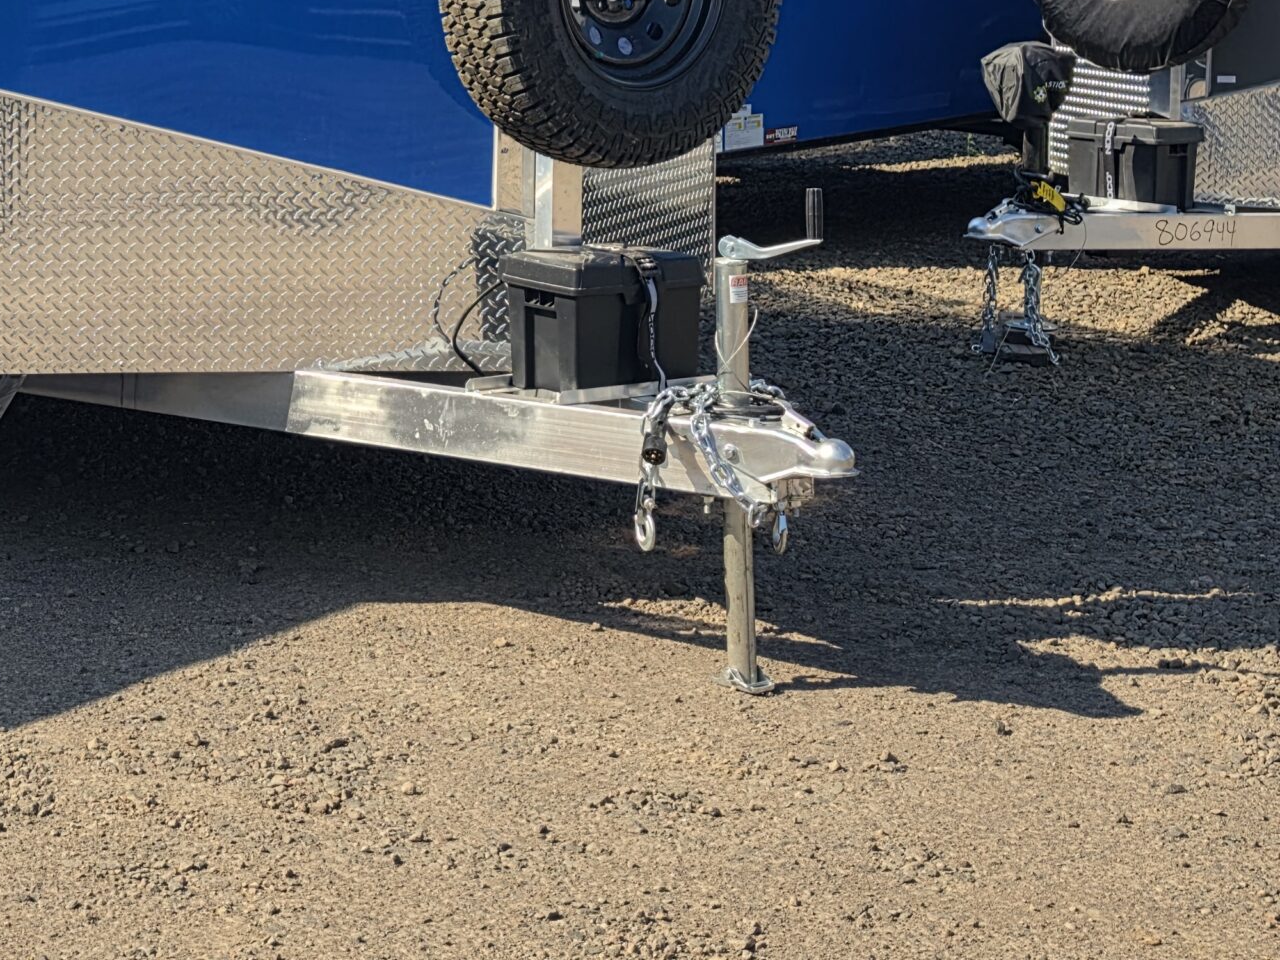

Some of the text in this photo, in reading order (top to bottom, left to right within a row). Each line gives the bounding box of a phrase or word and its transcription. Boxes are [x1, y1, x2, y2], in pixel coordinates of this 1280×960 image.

[1104, 121, 1115, 155] NOCO
[1105, 173, 1114, 199] OCO
[1155, 219, 1236, 246] 806944
